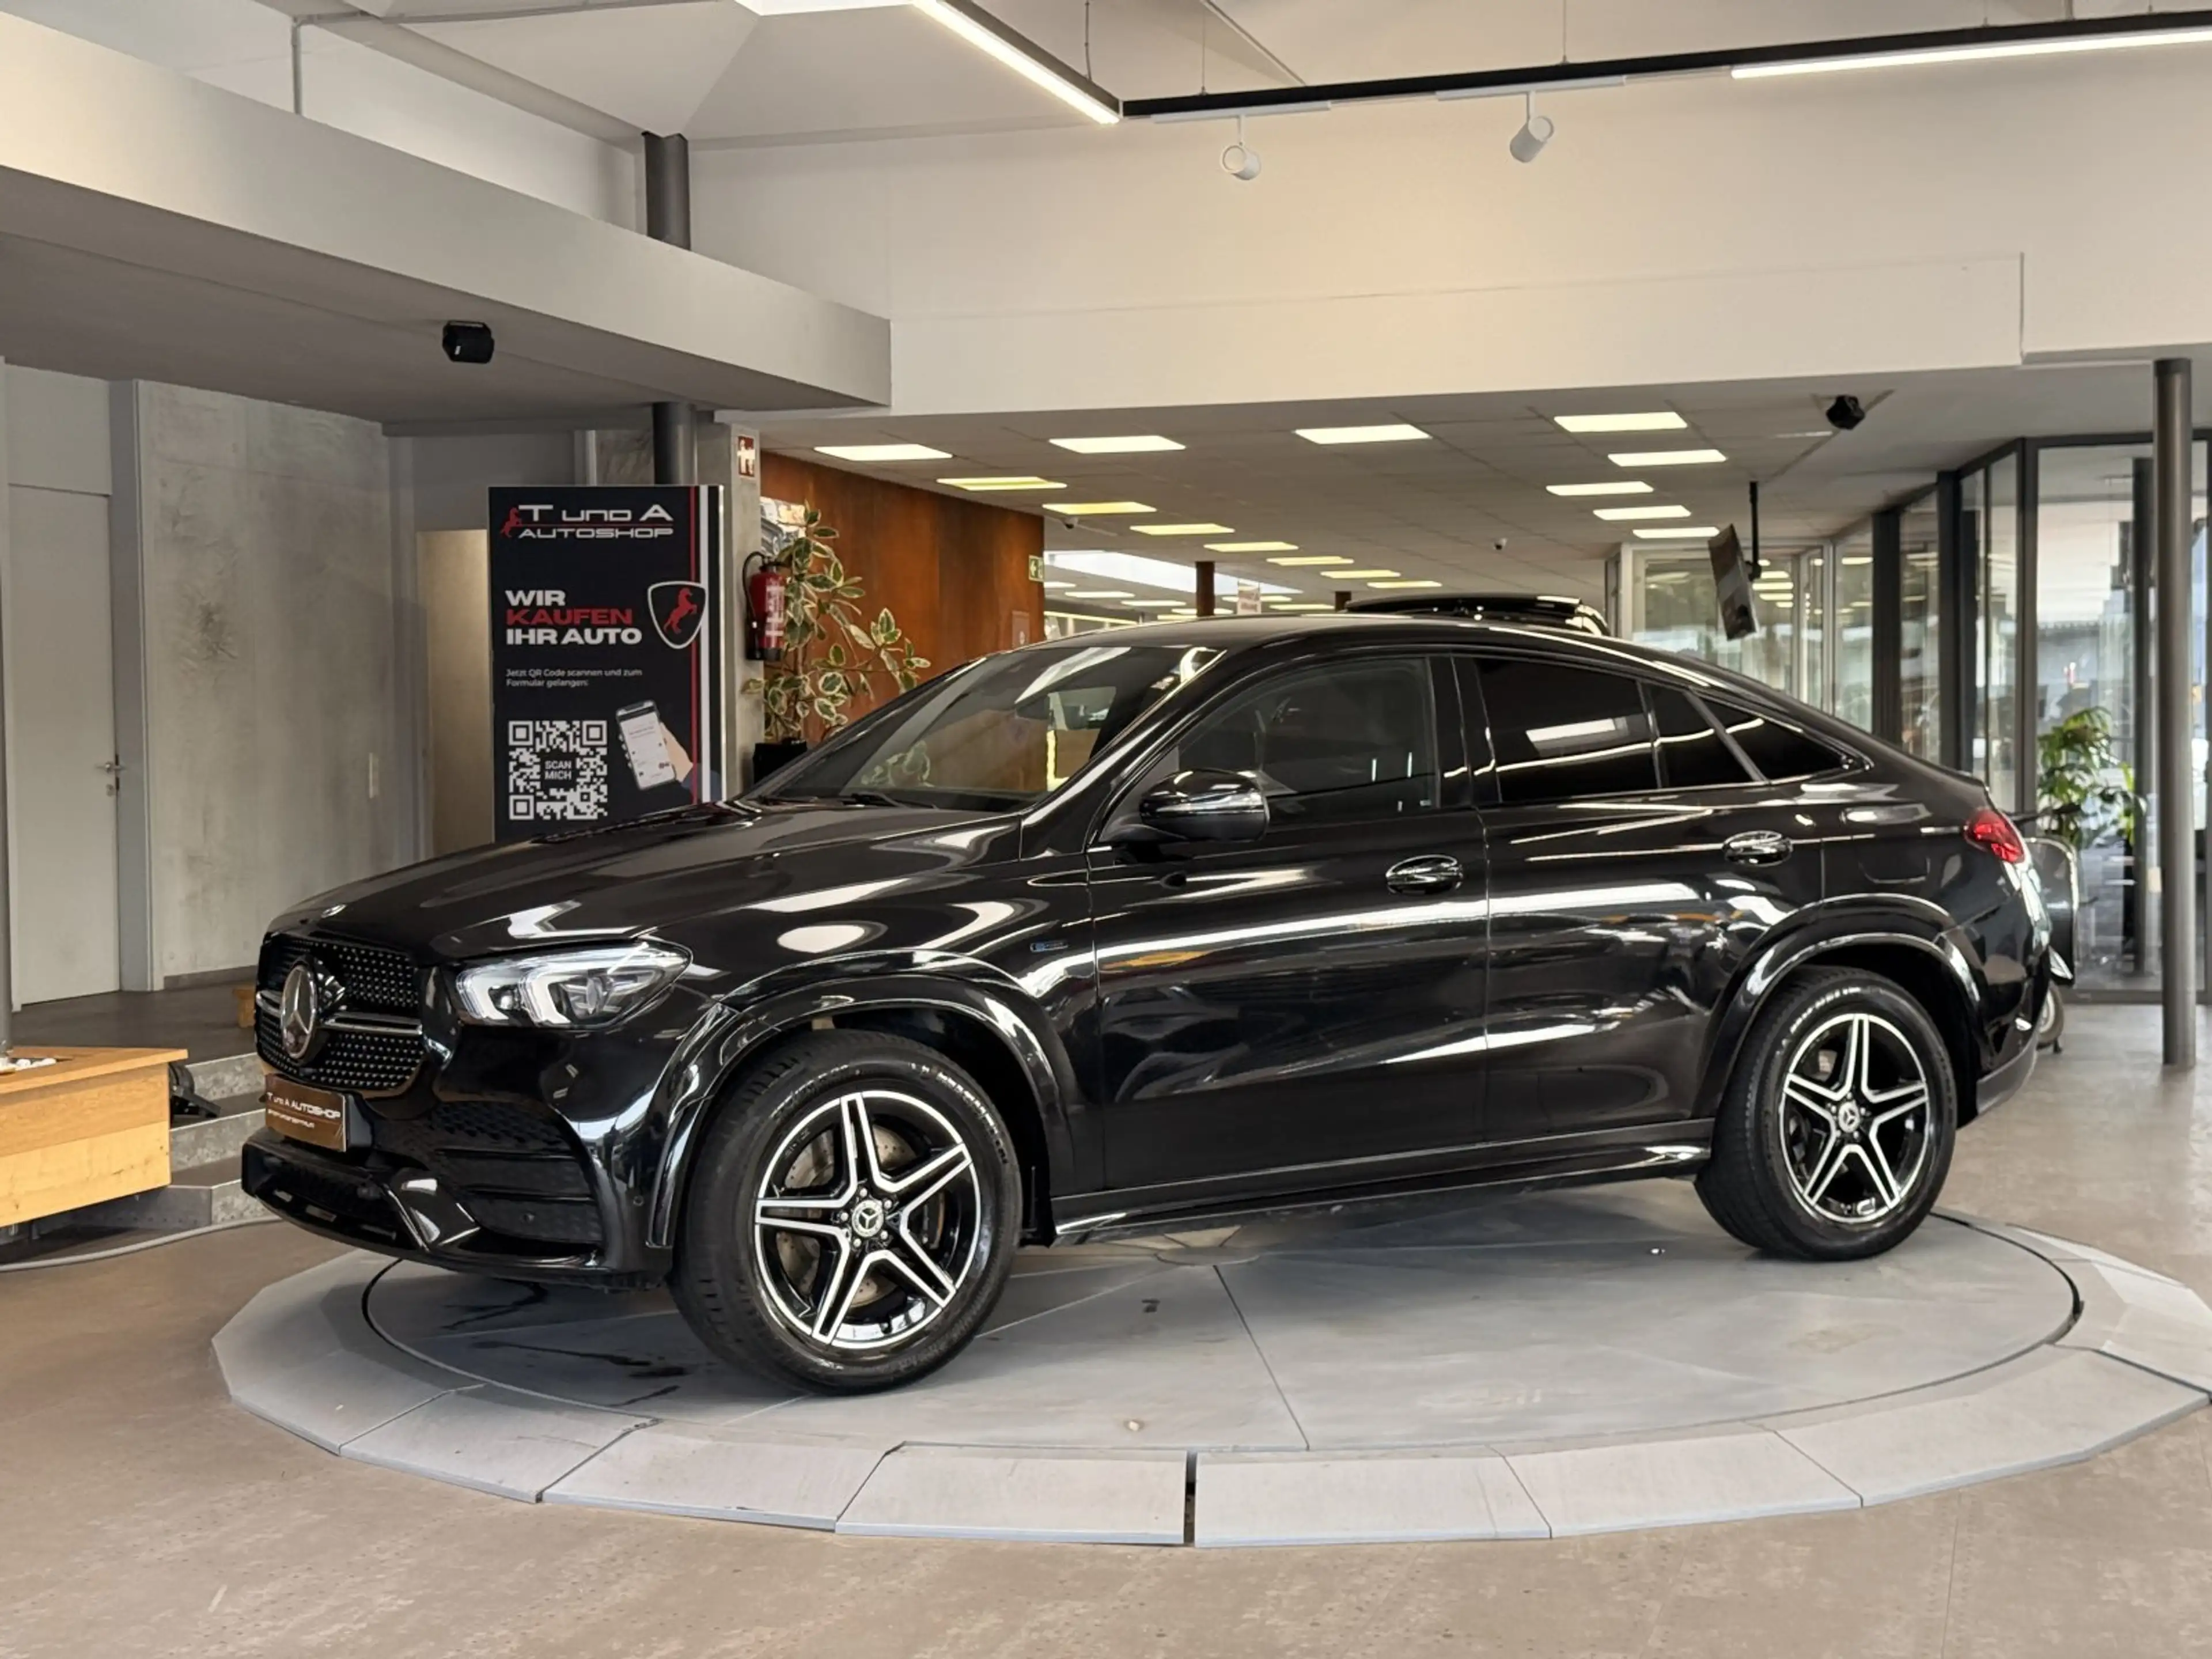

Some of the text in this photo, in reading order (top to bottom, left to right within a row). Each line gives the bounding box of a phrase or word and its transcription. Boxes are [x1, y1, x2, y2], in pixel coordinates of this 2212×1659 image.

[518, 505, 553, 521] T
[639, 504, 673, 521] A
[519, 528, 673, 539] AUTOSHOP
[505, 590, 566, 606] WIR
[506, 609, 632, 625] KAUFEN
[506, 628, 642, 645] IHR AUTO
[528, 669, 541, 677] QR
[545, 760, 571, 770] SCAN
[545, 770, 571, 779] MICH
